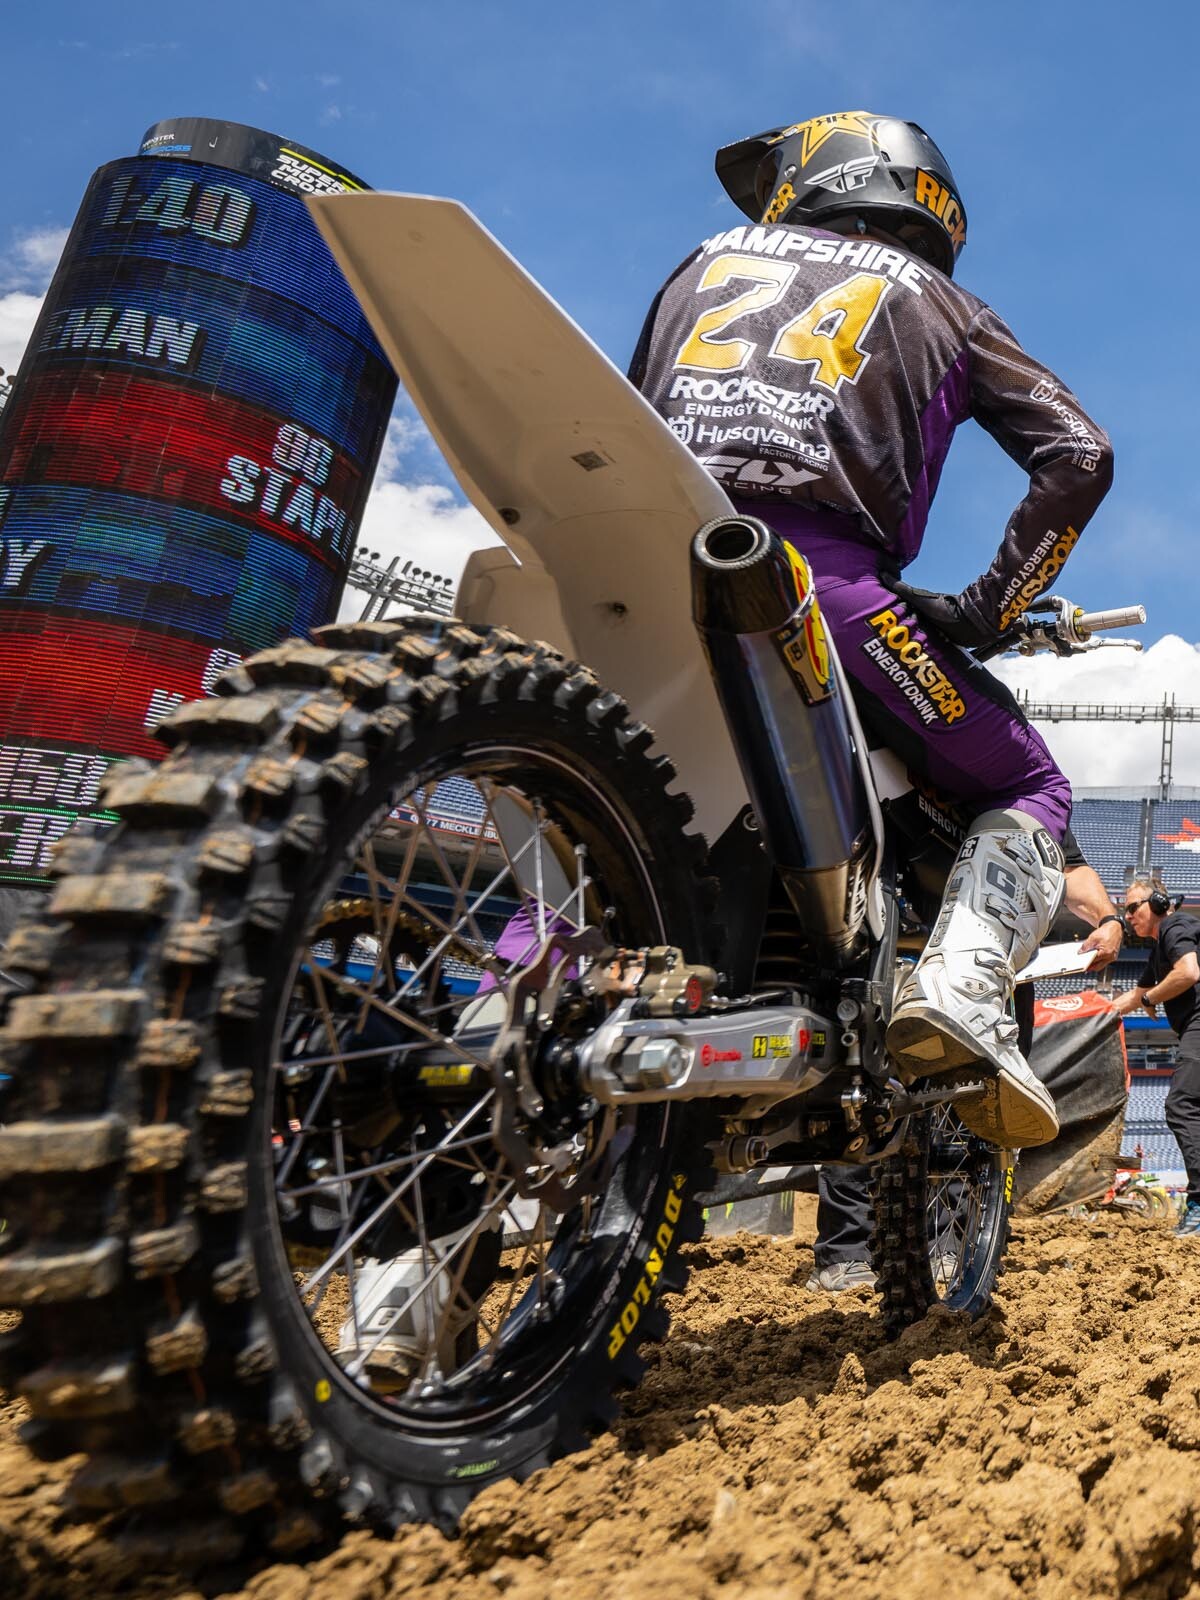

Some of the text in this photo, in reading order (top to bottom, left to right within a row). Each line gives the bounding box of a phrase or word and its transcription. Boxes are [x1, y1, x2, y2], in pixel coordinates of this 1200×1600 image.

[276, 154, 345, 192] SUPER
[697, 226, 933, 296] HAMPSHIRE
[673, 253, 893, 395] 24
[669, 375, 836, 422] ROCKSTAR
[684, 401, 814, 431] ENERGY DRINK
[696, 424, 832, 460] Husqvarna
[759, 447, 829, 472] FACTORY RACING
[1020, 529, 1059, 582] ENERGY
[863, 638, 939, 725] ENERGY DRINK
[869, 609, 967, 725] ROCKSTAR
[918, 794, 958, 838] ENERGY
[961, 839, 977, 858] 24
[607, 1188, 684, 1360] DUNLOP
